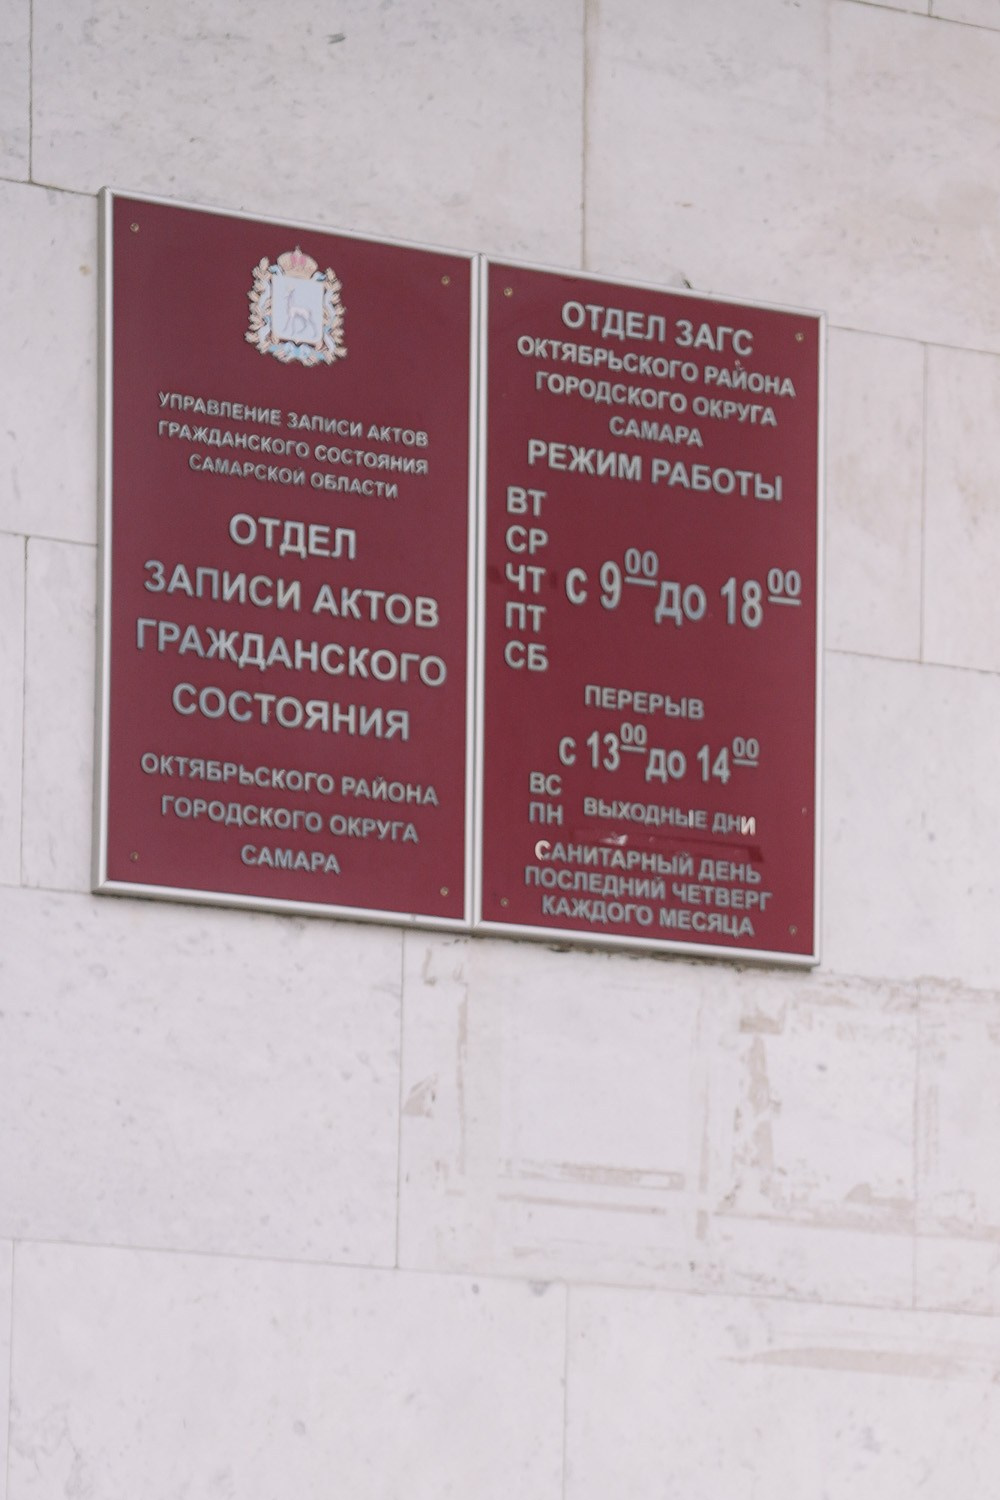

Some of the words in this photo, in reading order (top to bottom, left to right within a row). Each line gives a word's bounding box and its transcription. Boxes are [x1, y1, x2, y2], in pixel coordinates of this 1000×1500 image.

[561, 300, 666, 342] ОТДЕЛ
[674, 319, 753, 356] ЗАГС
[516, 335, 698, 383] ОКТЯБРЬСКОГО
[703, 365, 796, 398] РАЙОНА
[158, 391, 282, 426] УПРАВЛЕНИЕ
[287, 411, 362, 438] ЗАПИСИ
[367, 424, 429, 447] АКТОВ
[535, 371, 687, 414] ГОРОДСКОГО
[692, 396, 777, 427] ОКРУГА
[158, 420, 310, 459] ГРАЖДАНСКОГО
[315, 444, 429, 475] СОСТОЯНИЯ
[608, 416, 704, 448] САМАРА
[310, 473, 399, 499] ОБЛАСТИ
[528, 439, 642, 481] РЕЖИМ
[651, 458, 782, 501] РАБОТЫ
[506, 486, 547, 516] ВТ
[229, 513, 357, 559] ОТДЕЛ
[505, 525, 549, 554] СР
[144, 560, 302, 612] ЗАПИСИ
[312, 584, 439, 628] АКТОВ
[505, 562, 546, 593] ЧТ
[505, 601, 547, 633] ПТ
[136, 617, 447, 687] ГРАЖДАНСКОГО
[504, 640, 549, 672] СБ
[172, 682, 410, 741] СОСТОЯНИЯ
[585, 685, 705, 720] ПЕРЕРЫВ
[140, 752, 334, 796] ОКТЯБРЬСКОГО
[342, 776, 439, 806] РАЙОНА
[529, 771, 562, 796] ВС
[161, 795, 322, 833] ГОРОДСКОГО
[329, 814, 418, 844] ОКРУГА
[529, 802, 563, 825] ПН
[583, 797, 707, 829] ВЫХОДНЫЕ
[712, 811, 756, 836] ДНИ
[241, 844, 341, 874] САМАРА
[534, 839, 694, 877] САНИТАРНЫЙ
[699, 860, 761, 884] ДЕНЬ
[525, 865, 666, 900] ПОСЛЕДНИЙ
[672, 883, 772, 911] ЧЕТВЕРГ
[542, 895, 654, 926] КАЖДОГО
[659, 908, 755, 937] МЕСЯЦА
